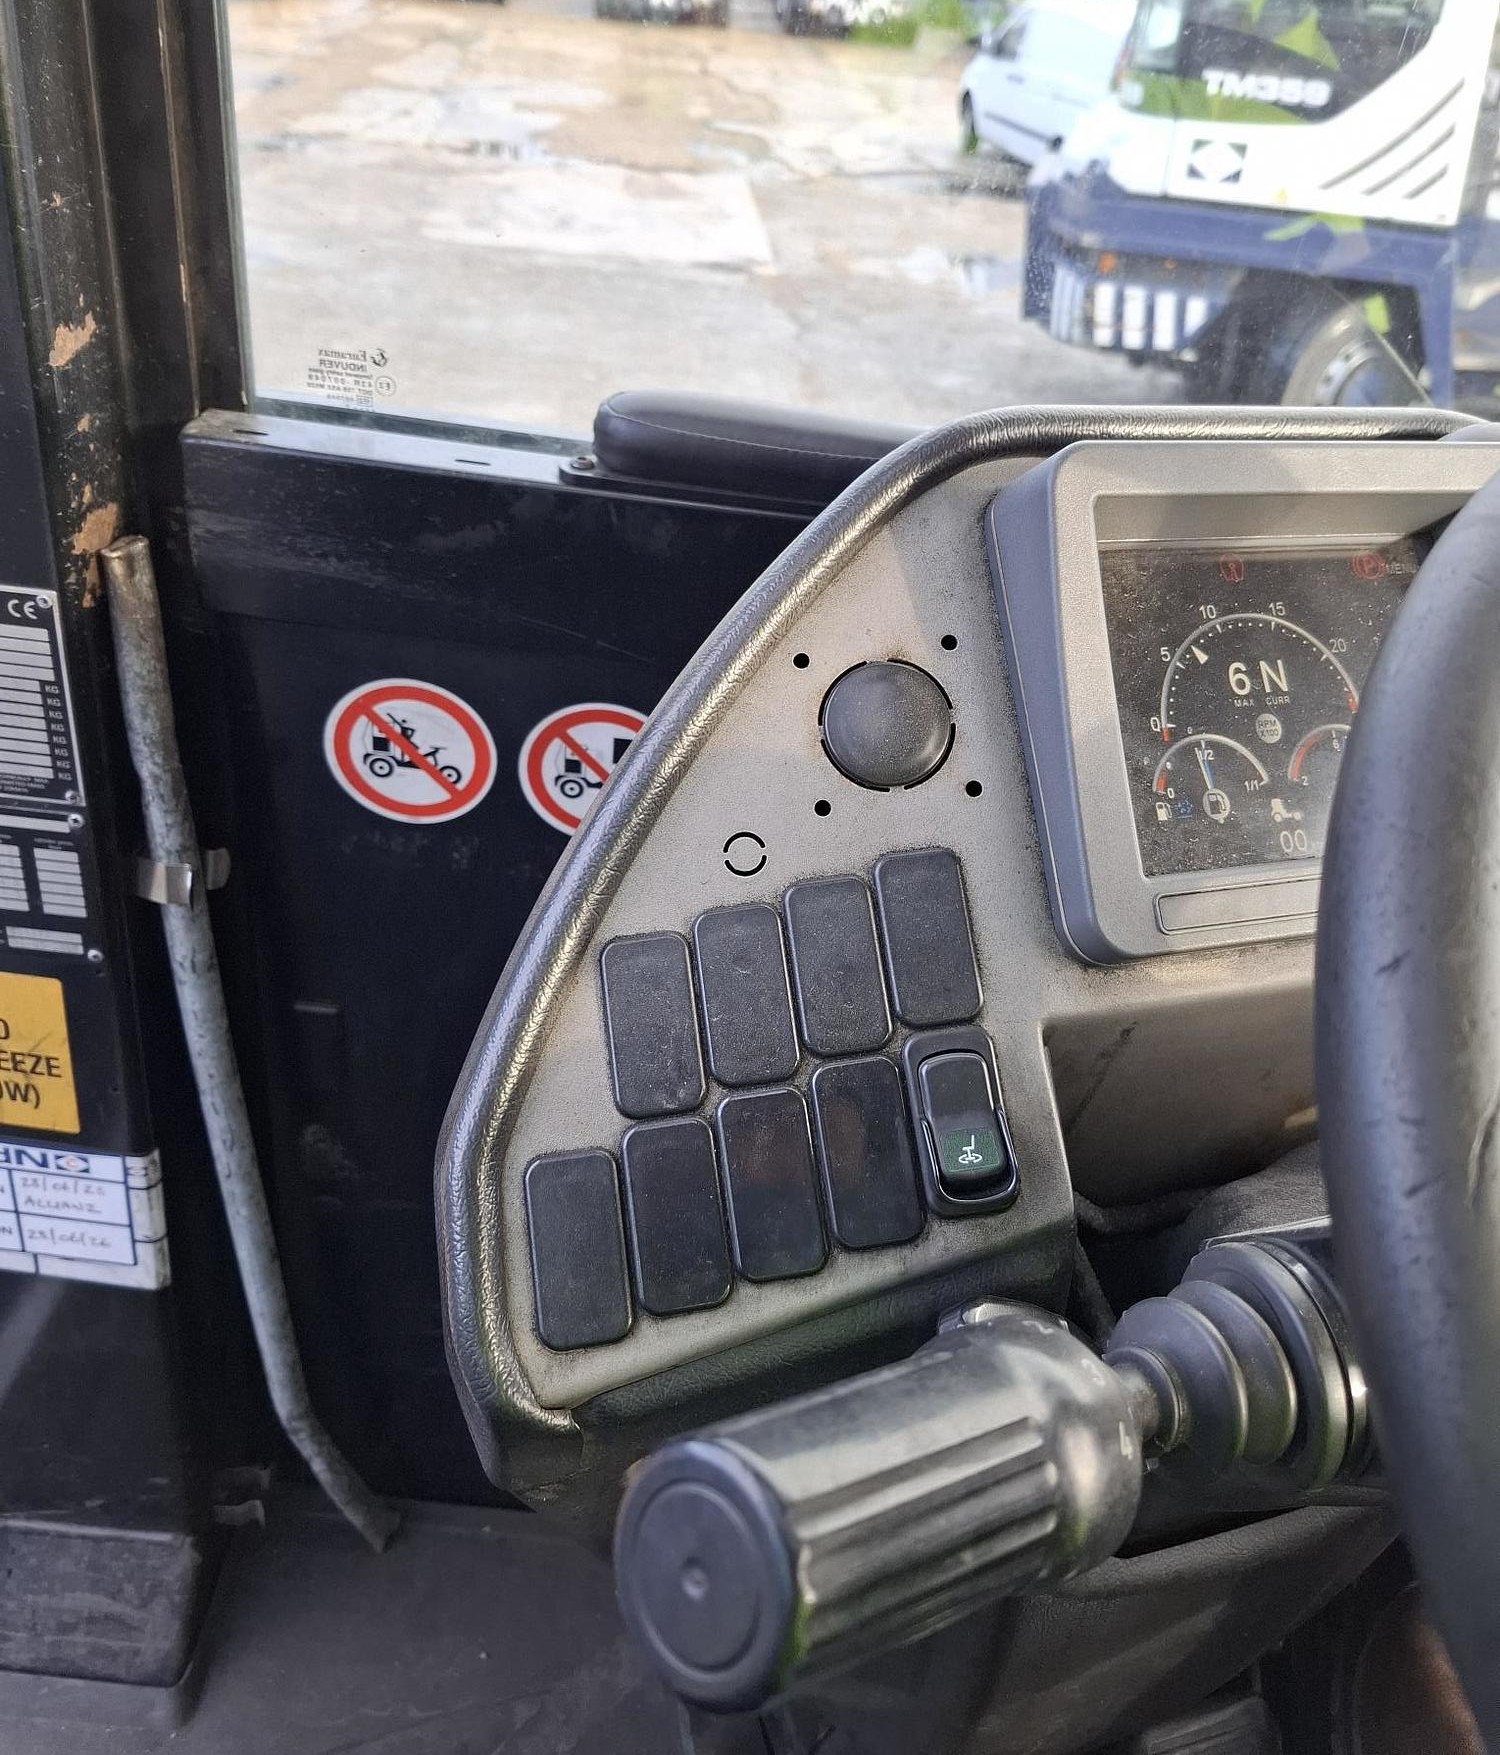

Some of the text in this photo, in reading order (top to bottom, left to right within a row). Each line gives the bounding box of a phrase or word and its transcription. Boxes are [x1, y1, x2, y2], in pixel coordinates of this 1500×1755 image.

[7, 599, 38, 620] CE
[1199, 601, 1287, 620] 10 15
[1160, 646, 1171, 662] 5
[1328, 638, 1347, 654] 20
[1228, 659, 1289, 696] 6 N
[1150, 716, 1161, 733] 0
